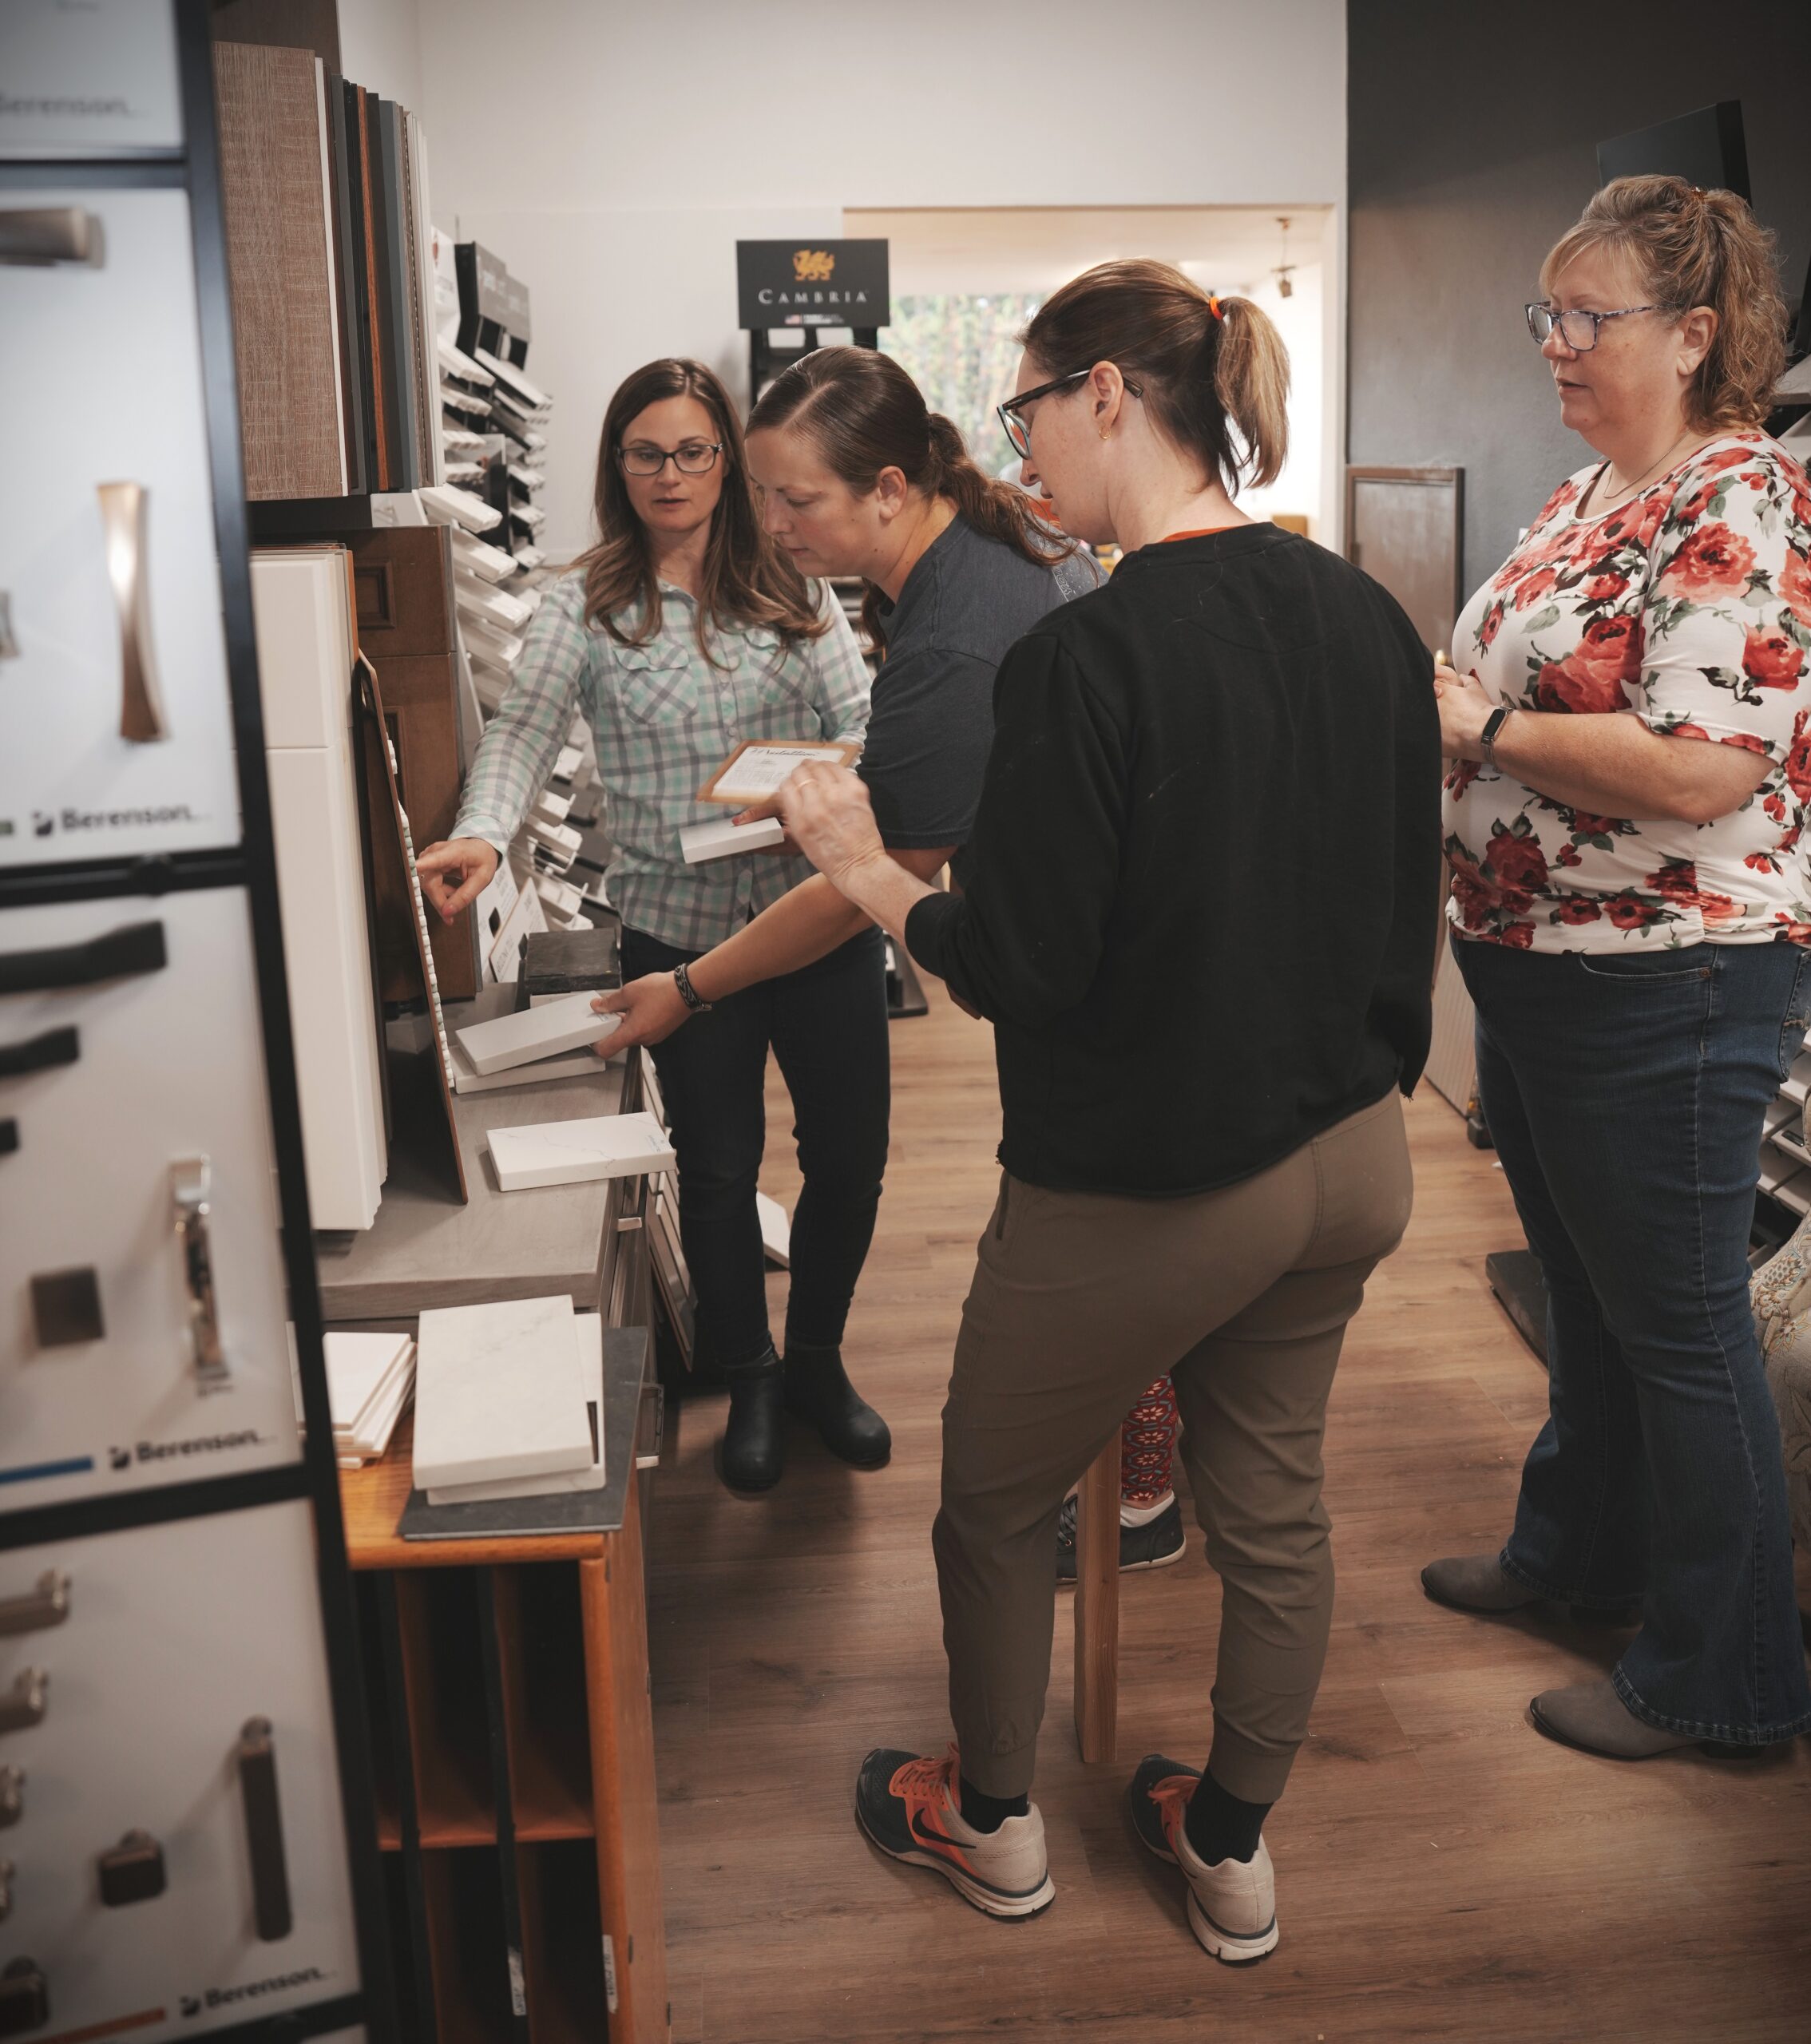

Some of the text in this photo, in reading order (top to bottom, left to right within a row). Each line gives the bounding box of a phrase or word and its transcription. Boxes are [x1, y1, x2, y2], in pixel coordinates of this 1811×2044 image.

[758, 287, 867, 305] CAMBRIA
[61, 806, 192, 830] Berenson
[136, 1429, 260, 1463] Berenson
[204, 1967, 322, 2009] Berenson
